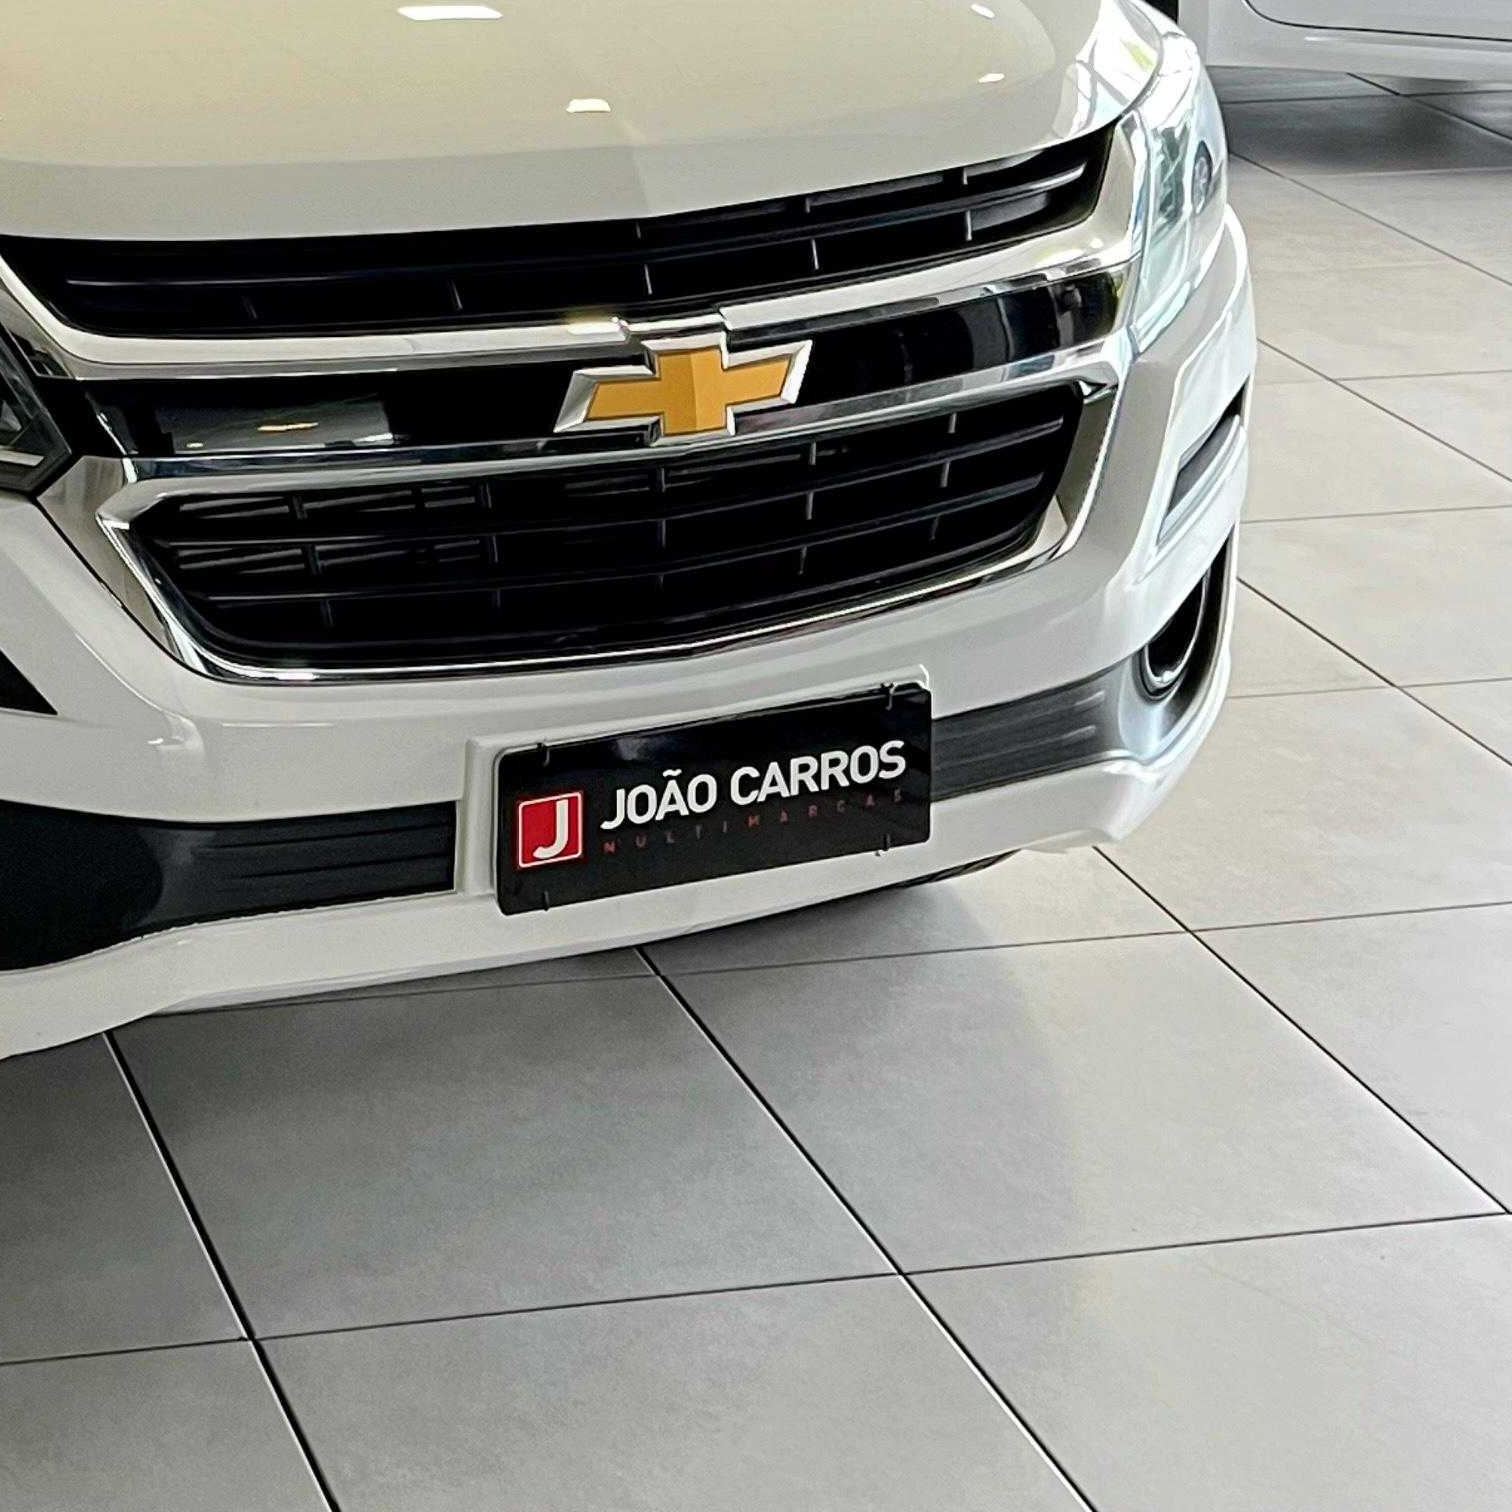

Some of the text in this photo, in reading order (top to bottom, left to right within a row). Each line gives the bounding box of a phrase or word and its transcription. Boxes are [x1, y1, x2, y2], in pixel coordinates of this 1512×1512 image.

[600, 740, 907, 831] JOÃO CARROS
[533, 799, 570, 860] J
